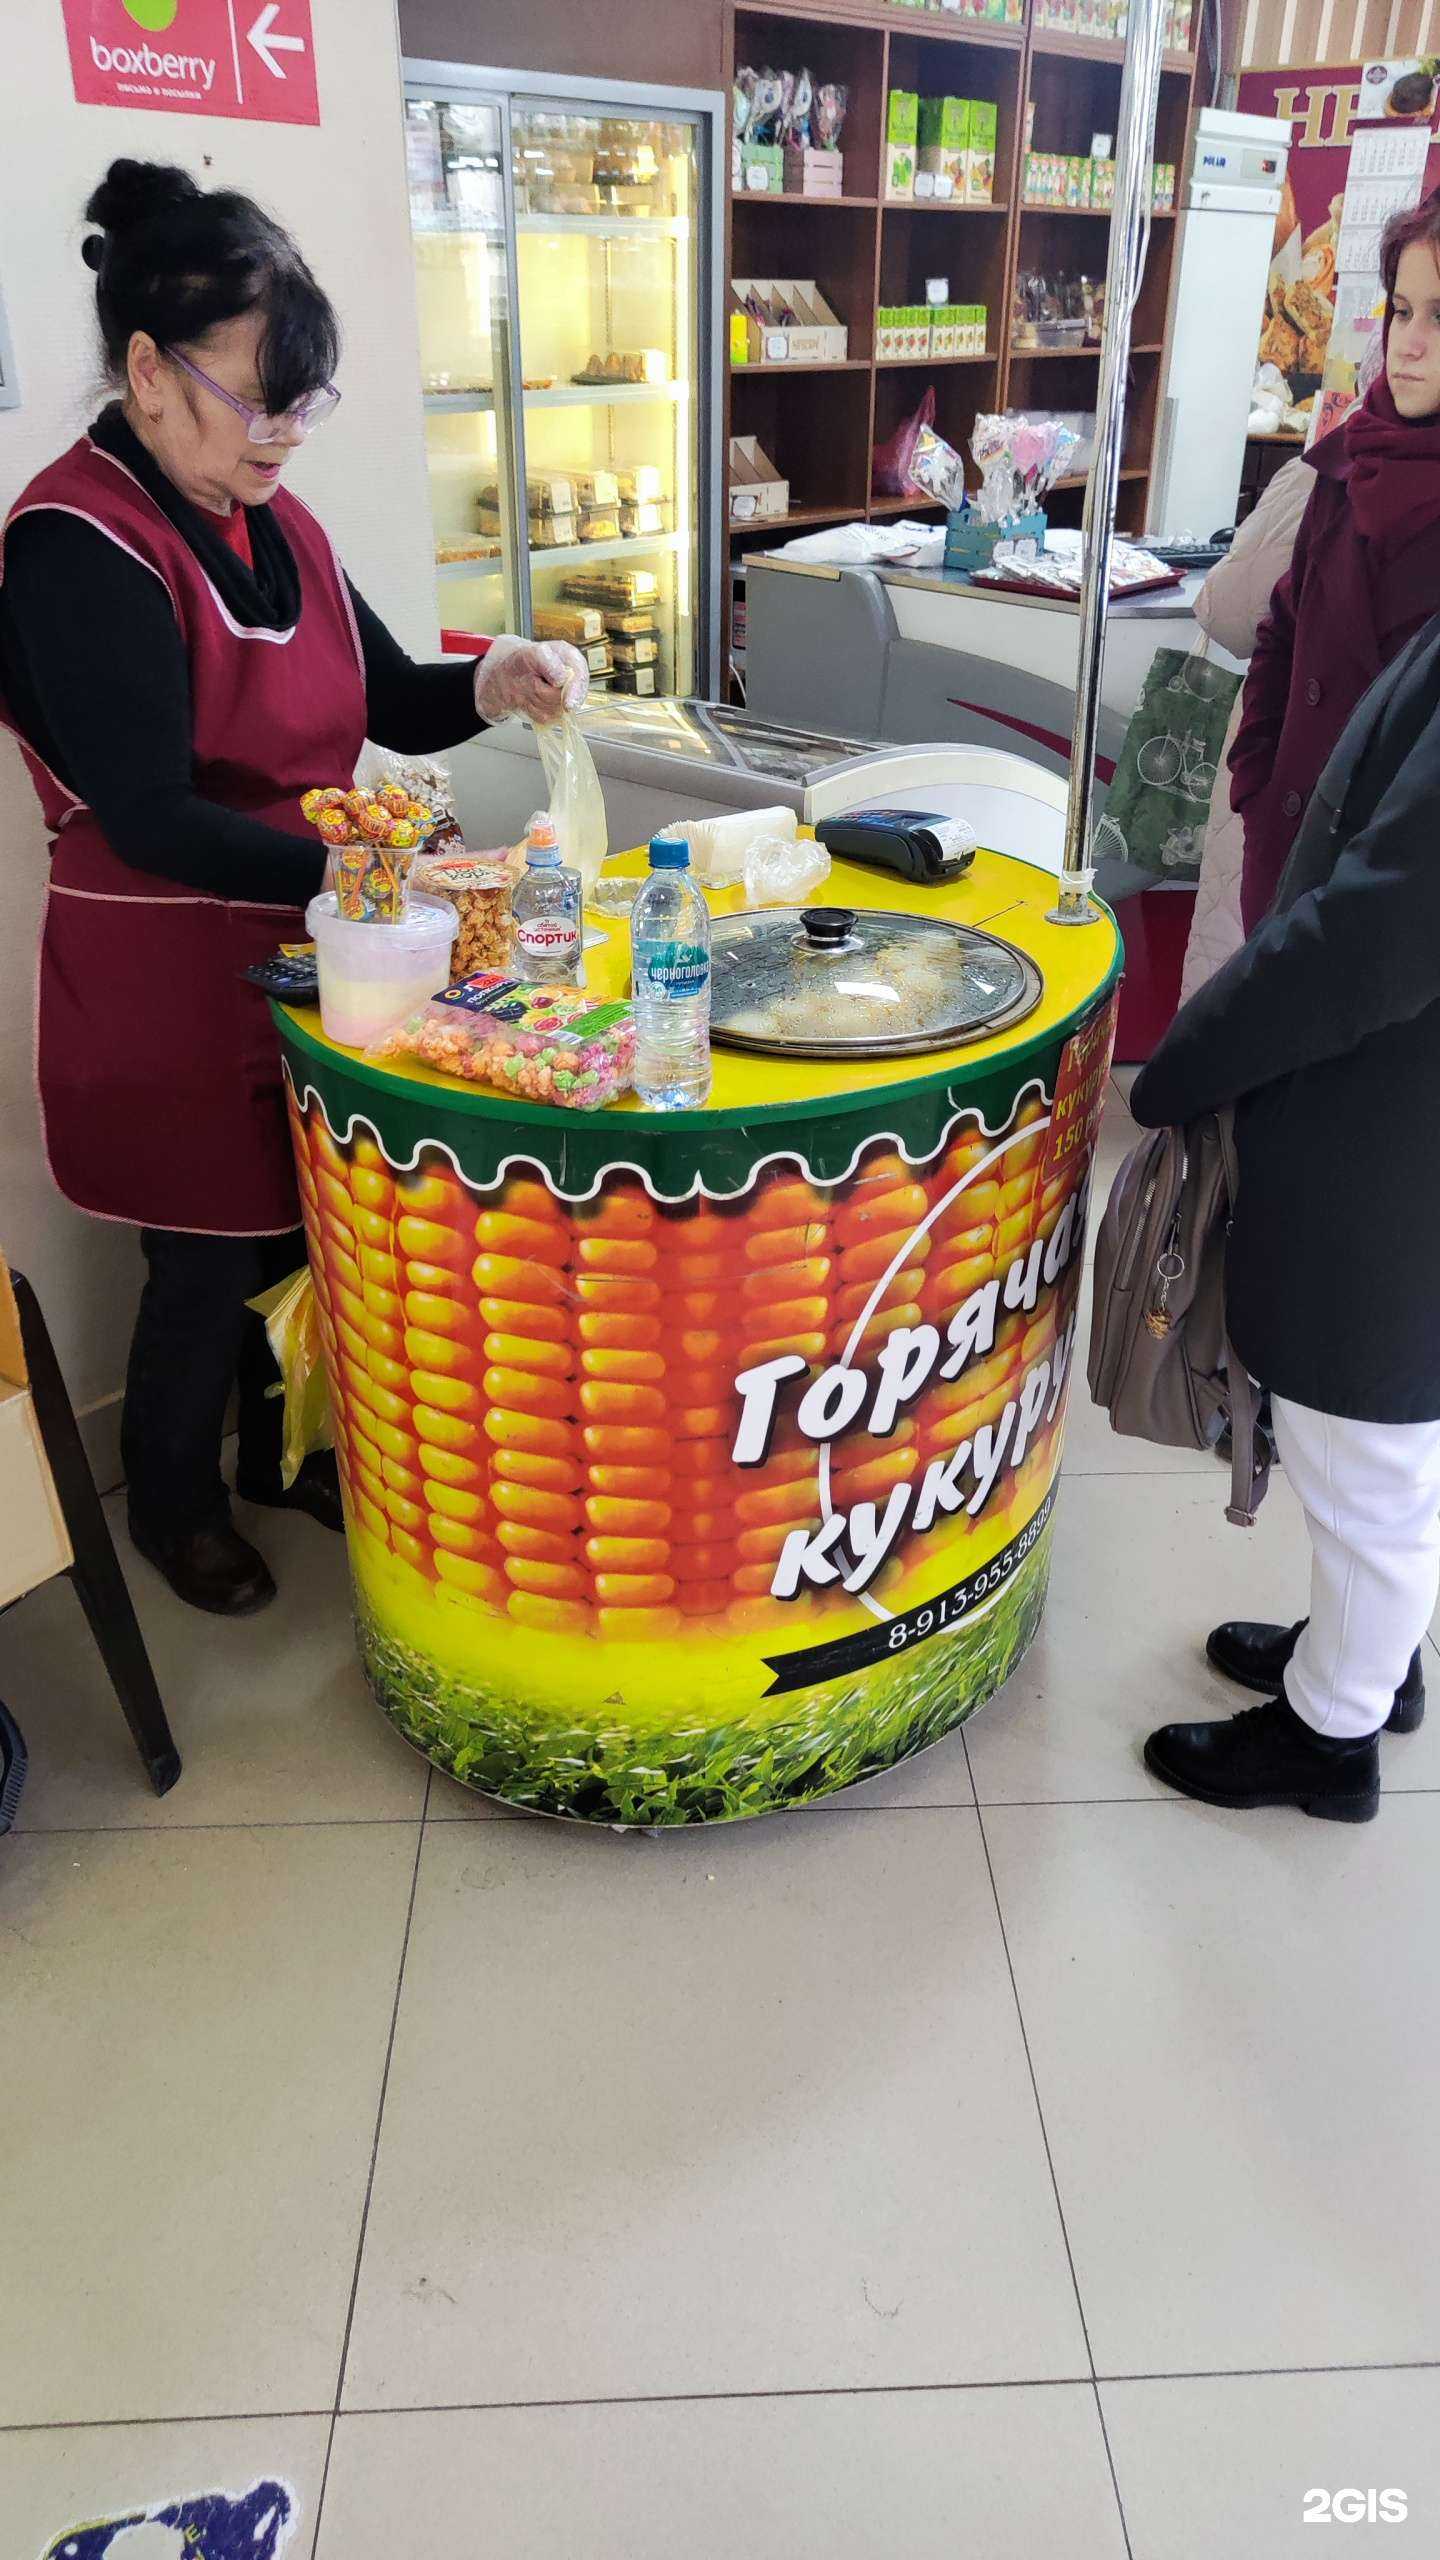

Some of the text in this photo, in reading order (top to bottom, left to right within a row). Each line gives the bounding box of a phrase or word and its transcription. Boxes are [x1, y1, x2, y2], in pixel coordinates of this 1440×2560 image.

[90, 36, 216, 90] boxberry
[518, 930, 576, 947] Спортик
[1053, 1117, 1083, 1161] 150
[771, 1311, 1076, 1597] кукуру
[888, 1497, 1051, 1649] 8-913-955-8899
